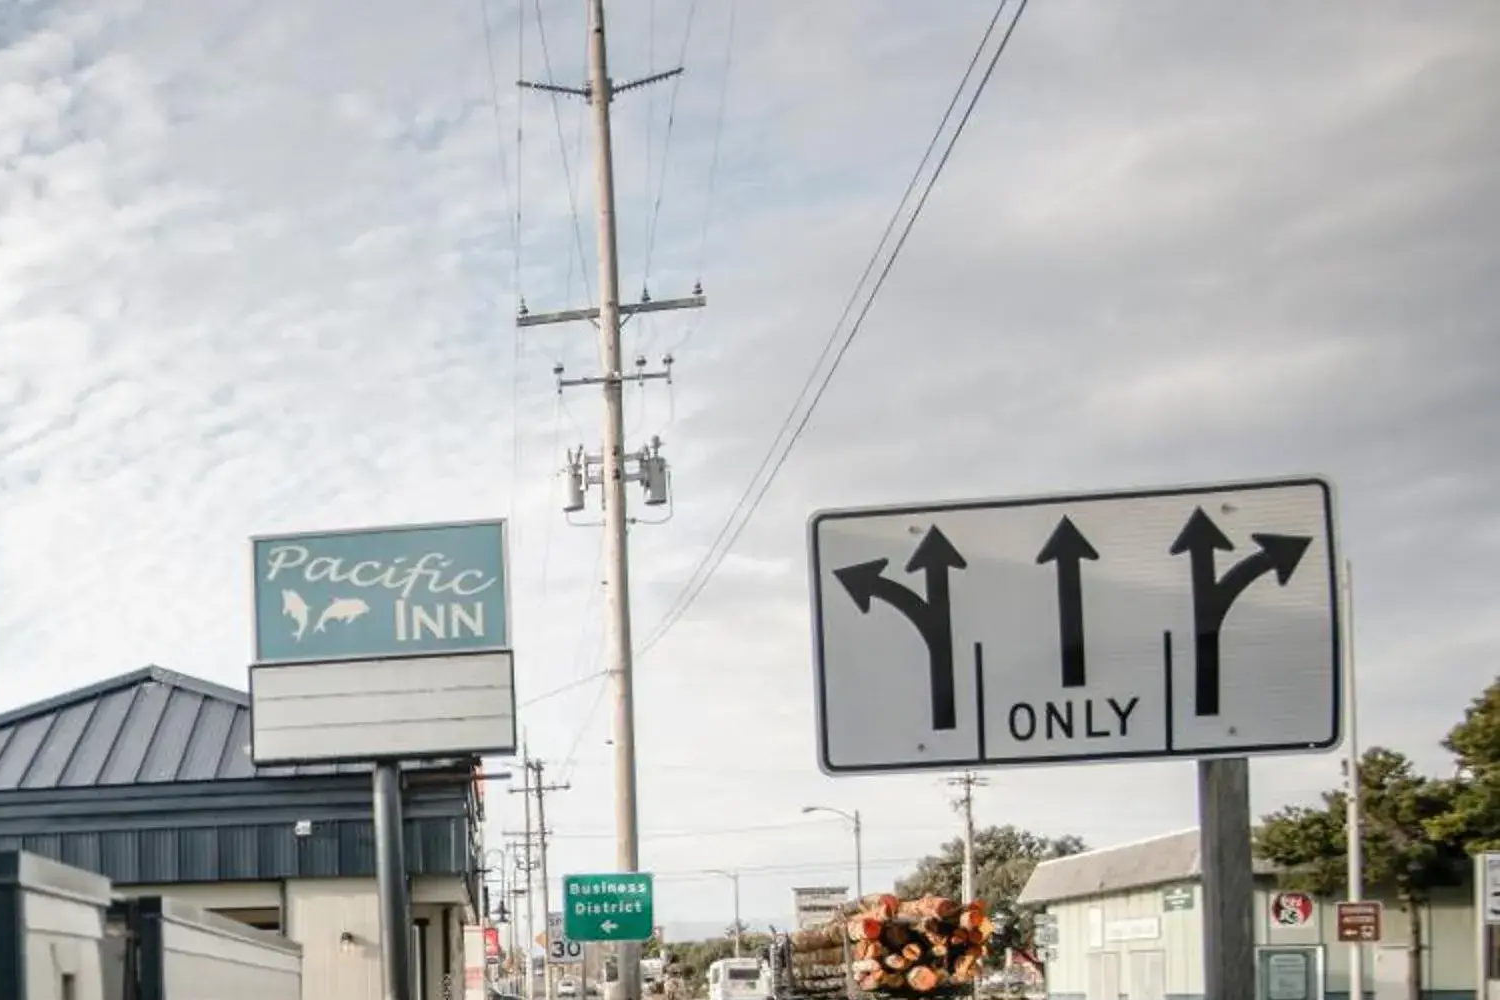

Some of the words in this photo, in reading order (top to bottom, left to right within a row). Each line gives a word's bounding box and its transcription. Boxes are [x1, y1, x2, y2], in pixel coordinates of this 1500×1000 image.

[265, 545, 497, 598] Pacific
[395, 599, 485, 641] INN
[1008, 696, 1140, 741] ONLY
[569, 880, 646, 895] Business
[574, 899, 642, 916] District
[551, 940, 581, 958] 30
